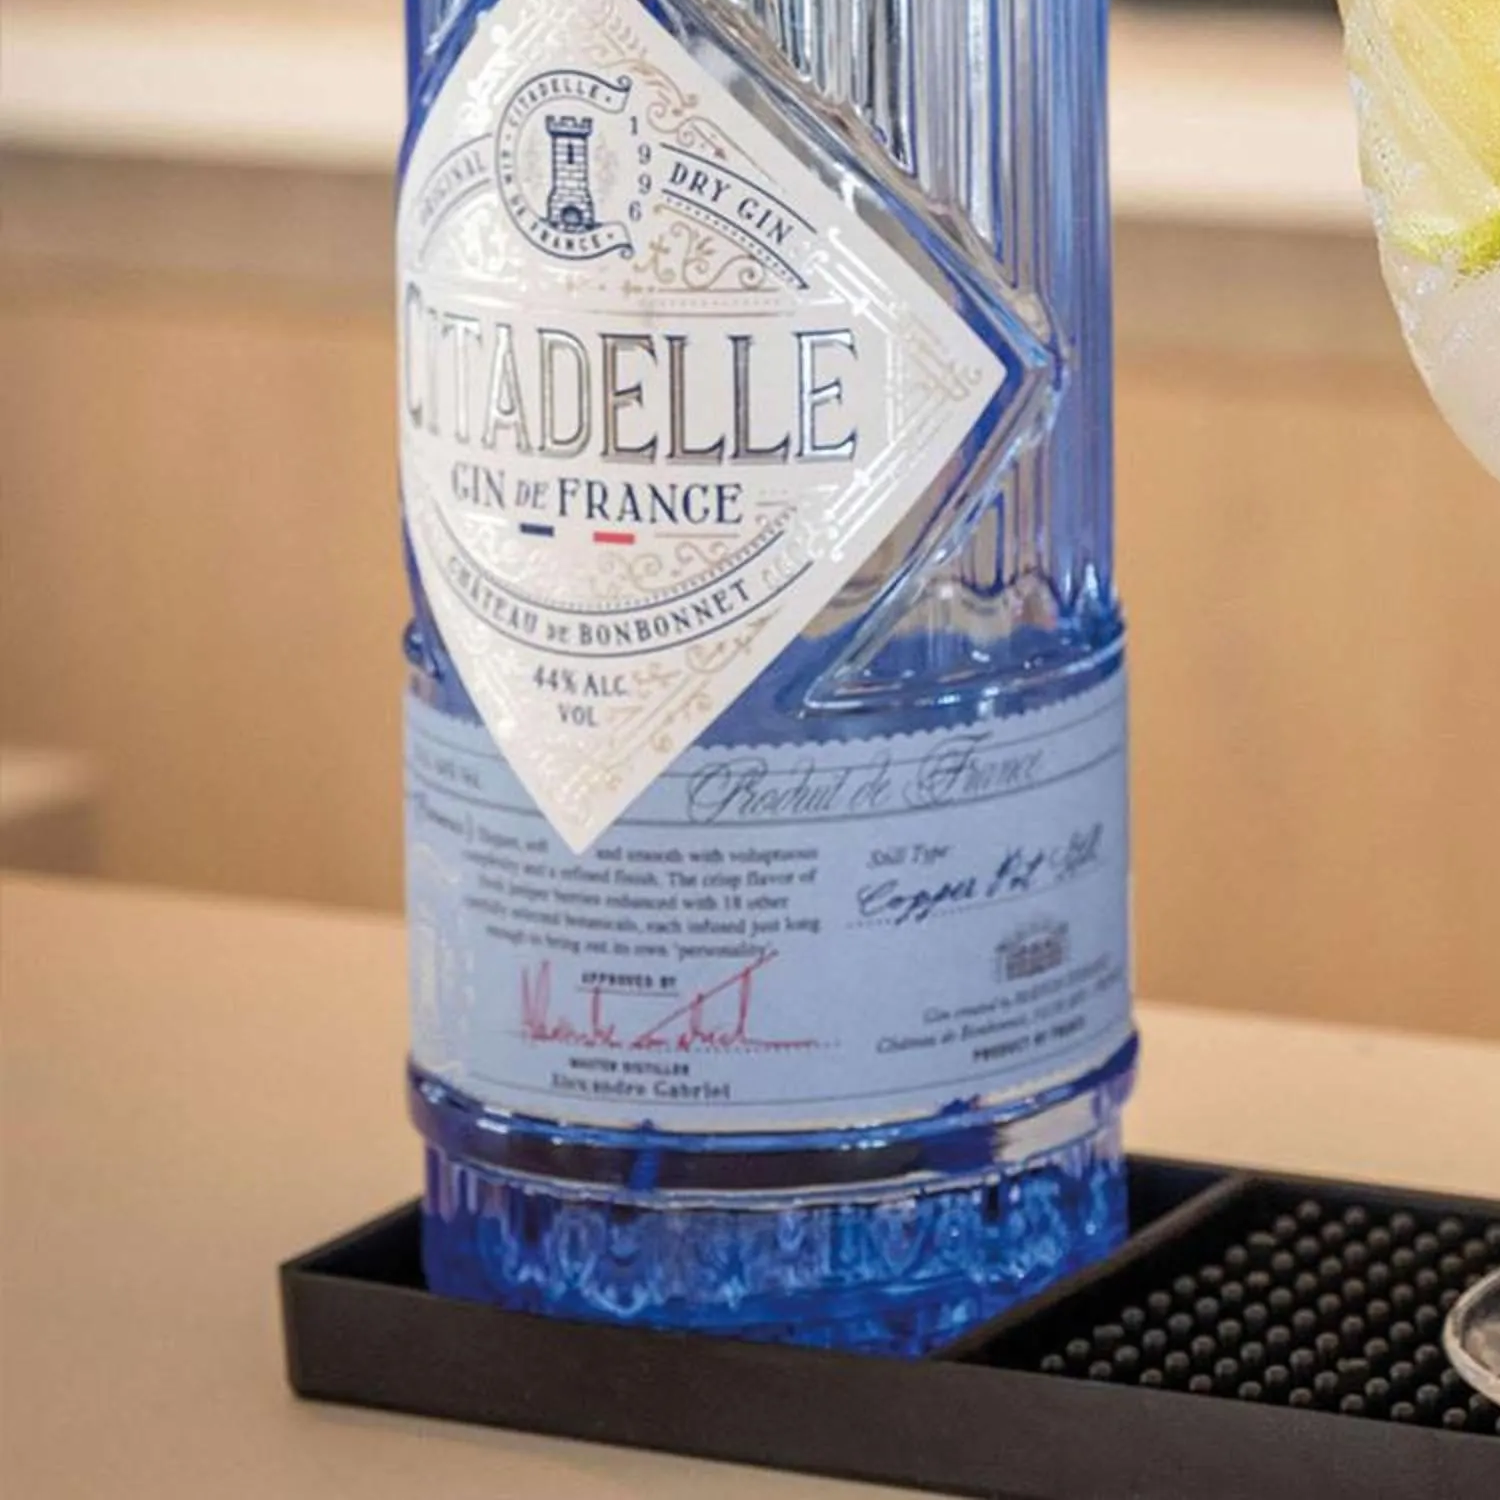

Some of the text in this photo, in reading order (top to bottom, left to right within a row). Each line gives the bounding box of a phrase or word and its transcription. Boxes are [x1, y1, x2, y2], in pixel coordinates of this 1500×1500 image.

[670, 161, 793, 244] DRY GIN
[404, 281, 859, 464] CITADELLE
[450, 460, 744, 525] GIN DE FRANCE
[578, 578, 751, 647] BONBONNET
[532, 665, 577, 691] 44%
[558, 703, 599, 727] VOL
[687, 756, 853, 826] Produit
[904, 731, 1045, 806] France
[689, 848, 723, 863] with
[668, 871, 697, 888] The
[702, 873, 742, 891] crisp
[747, 870, 794, 887] flavor
[798, 867, 818, 883] of
[856, 876, 977, 926] Copper
[985, 846, 1045, 898] Pot
[682, 895, 718, 910] with
[747, 895, 789, 910] other
[785, 916, 821, 936] long
[582, 972, 677, 990] APPROVED BY
[622, 1060, 691, 1077] DISTILLER
[653, 1078, 732, 1100] Gabriel
